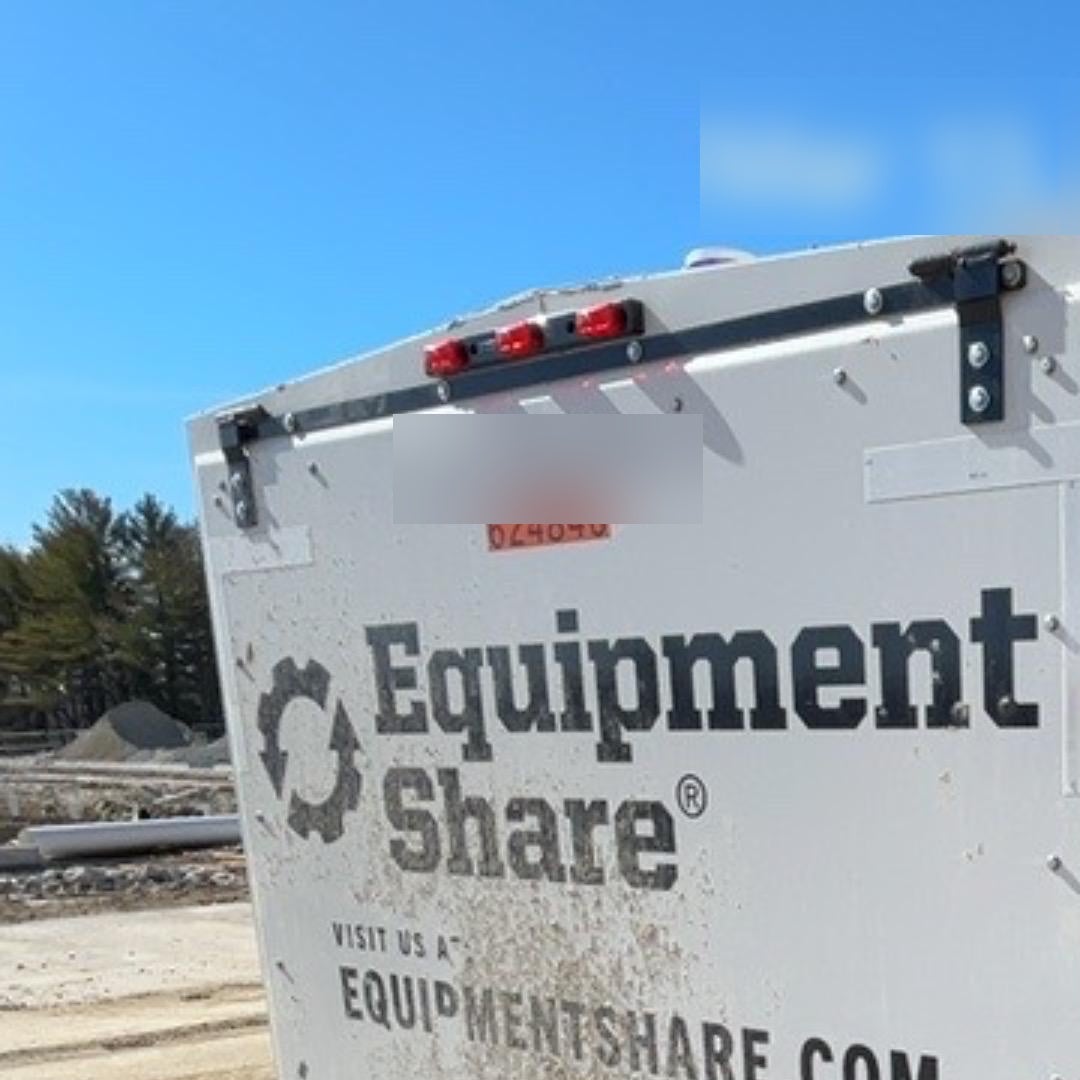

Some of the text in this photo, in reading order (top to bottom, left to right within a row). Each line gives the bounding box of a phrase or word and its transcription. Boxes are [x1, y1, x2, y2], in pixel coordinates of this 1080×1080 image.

[365, 587, 1039, 762] Equipment
[384, 767, 678, 891] Share
[332, 921, 386, 953] VISIT
[398, 929, 426, 959] US
